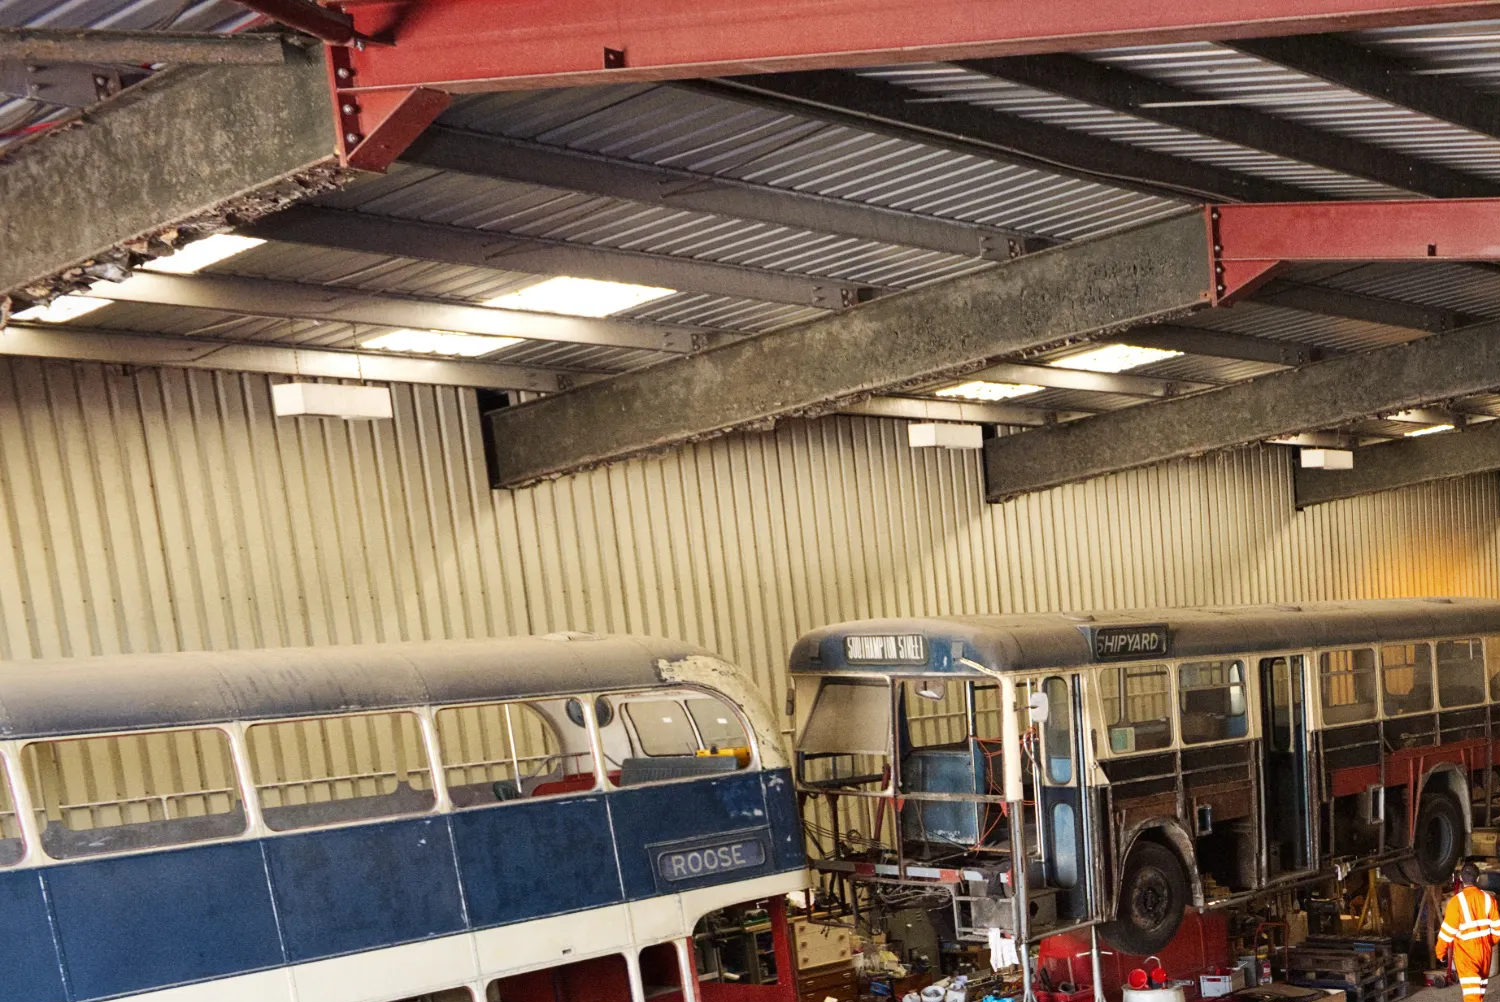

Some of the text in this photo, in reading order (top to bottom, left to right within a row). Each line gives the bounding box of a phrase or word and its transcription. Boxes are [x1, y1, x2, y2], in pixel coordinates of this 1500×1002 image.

[847, 635, 924, 659] SOUTHAMPTON STREET
[1097, 632, 1158, 653] SHIPYARD
[671, 844, 746, 877] ROOSE
